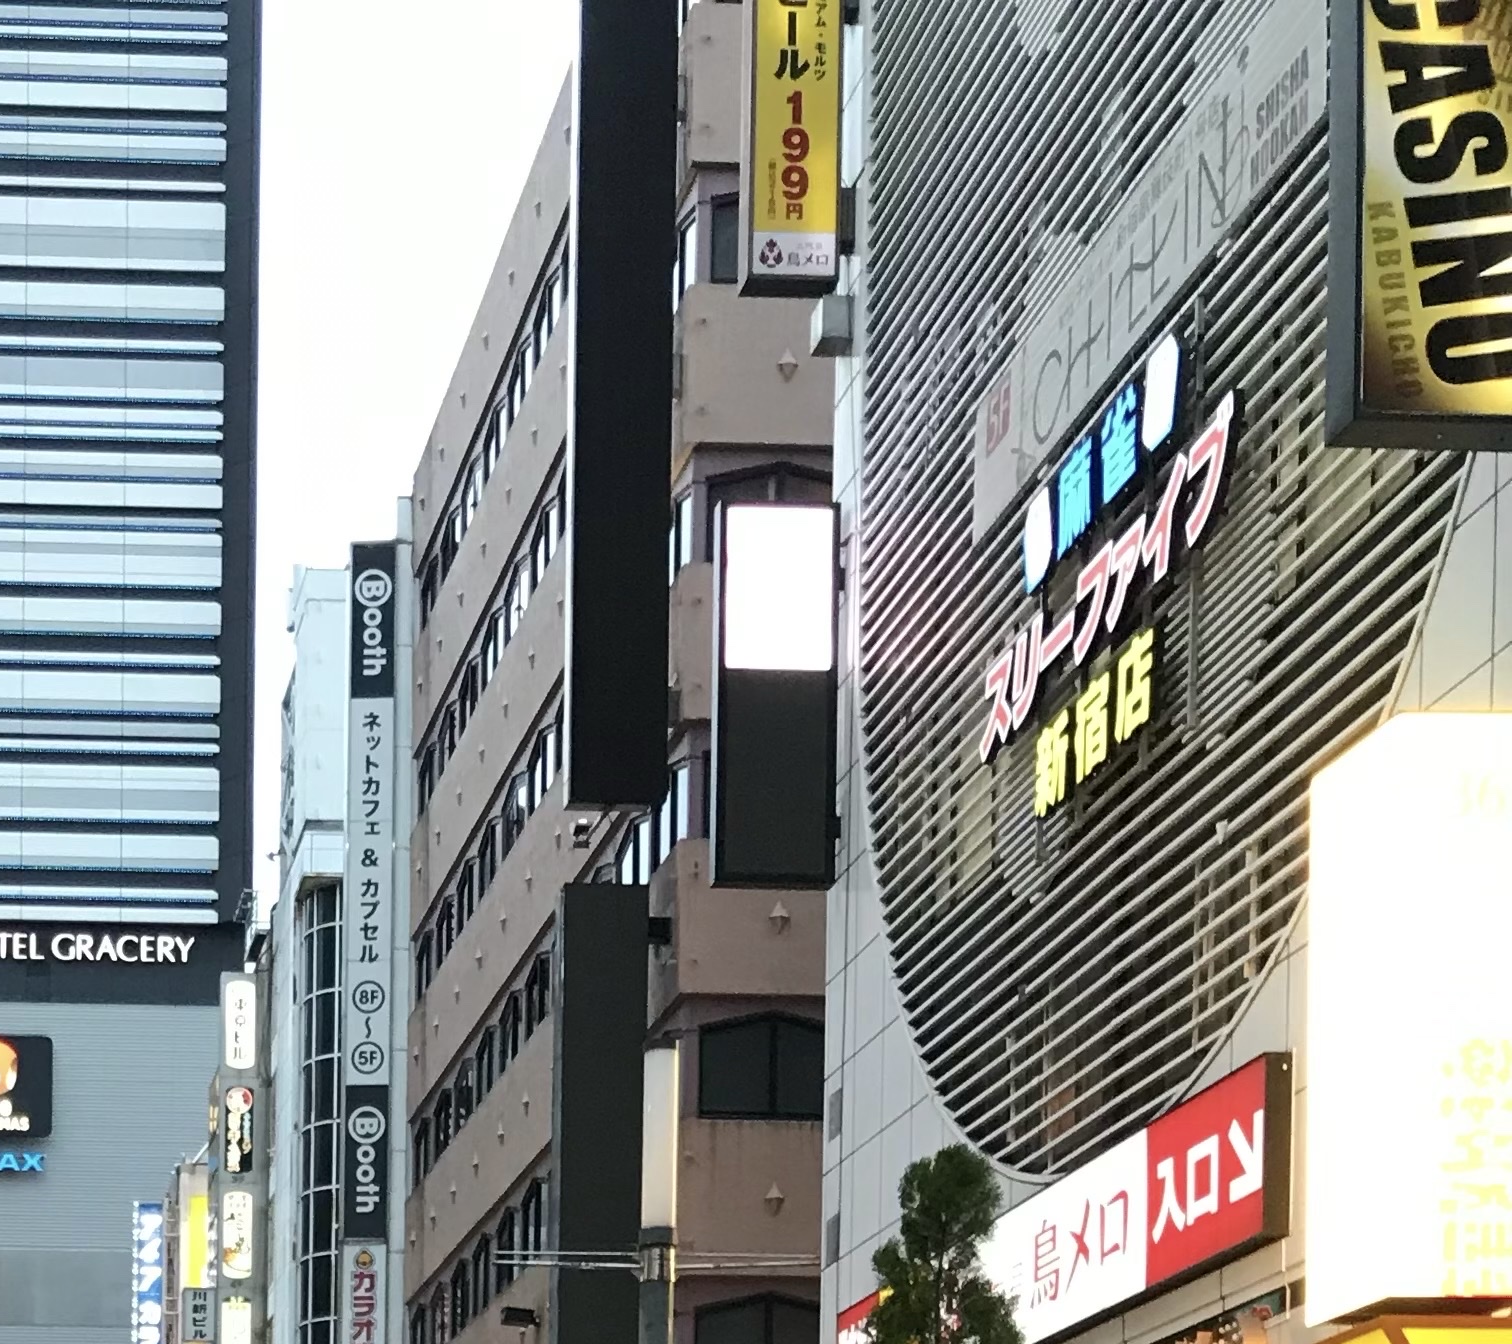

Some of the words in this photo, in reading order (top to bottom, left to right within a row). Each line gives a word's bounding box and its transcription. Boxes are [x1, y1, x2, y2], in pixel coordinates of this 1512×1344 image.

[774, 0, 810, 80] ール
[814, 0, 827, 81] アム・モルツ
[782, 91, 809, 220] 199円
[1368, 200, 1424, 397] KABUKICHO
[354, 568, 393, 677] Booth
[980, 390, 1235, 763] スリーファイブ
[361, 712, 382, 835] ネットカフェ
[1035, 627, 1154, 817] 新宿店
[361, 849, 379, 867] &
[51, 933, 195, 962] GRACERY
[359, 878, 381, 964] カプセル
[348, 1105, 386, 1214] Booth
[1030, 1190, 1129, 1309] 鳥メロ
